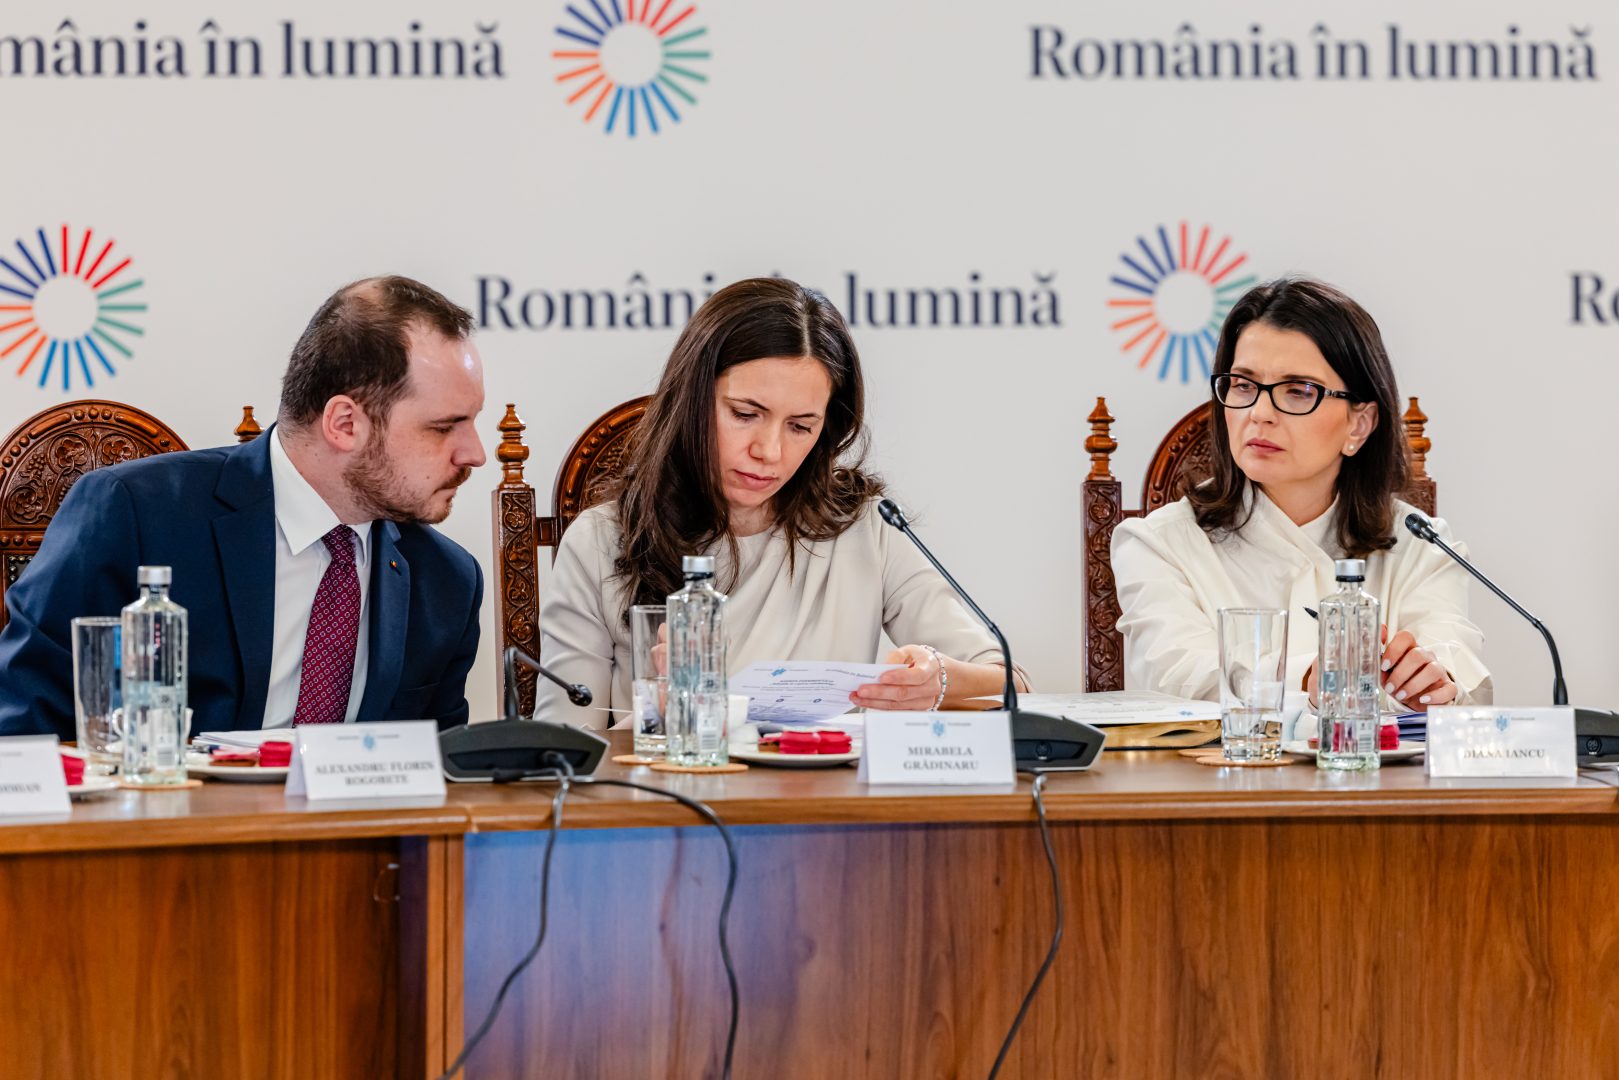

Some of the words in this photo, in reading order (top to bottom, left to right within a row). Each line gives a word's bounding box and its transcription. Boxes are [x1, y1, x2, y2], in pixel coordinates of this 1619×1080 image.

[0, 18, 189, 78] mânia
[200, 19, 264, 78] în
[281, 20, 506, 79] lumină
[1028, 23, 1301, 80] România
[1312, 23, 1371, 80] în
[1387, 23, 1599, 80] lumină
[846, 272, 1063, 330] lumină
[1568, 271, 1619, 326] R
[315, 762, 387, 775] ALEXANDRU
[390, 760, 436, 772] FLORIN
[903, 759, 978, 771] GRĂDINARU
[907, 746, 974, 757] MIRABELA
[1505, 748, 1546, 759] IANCU
